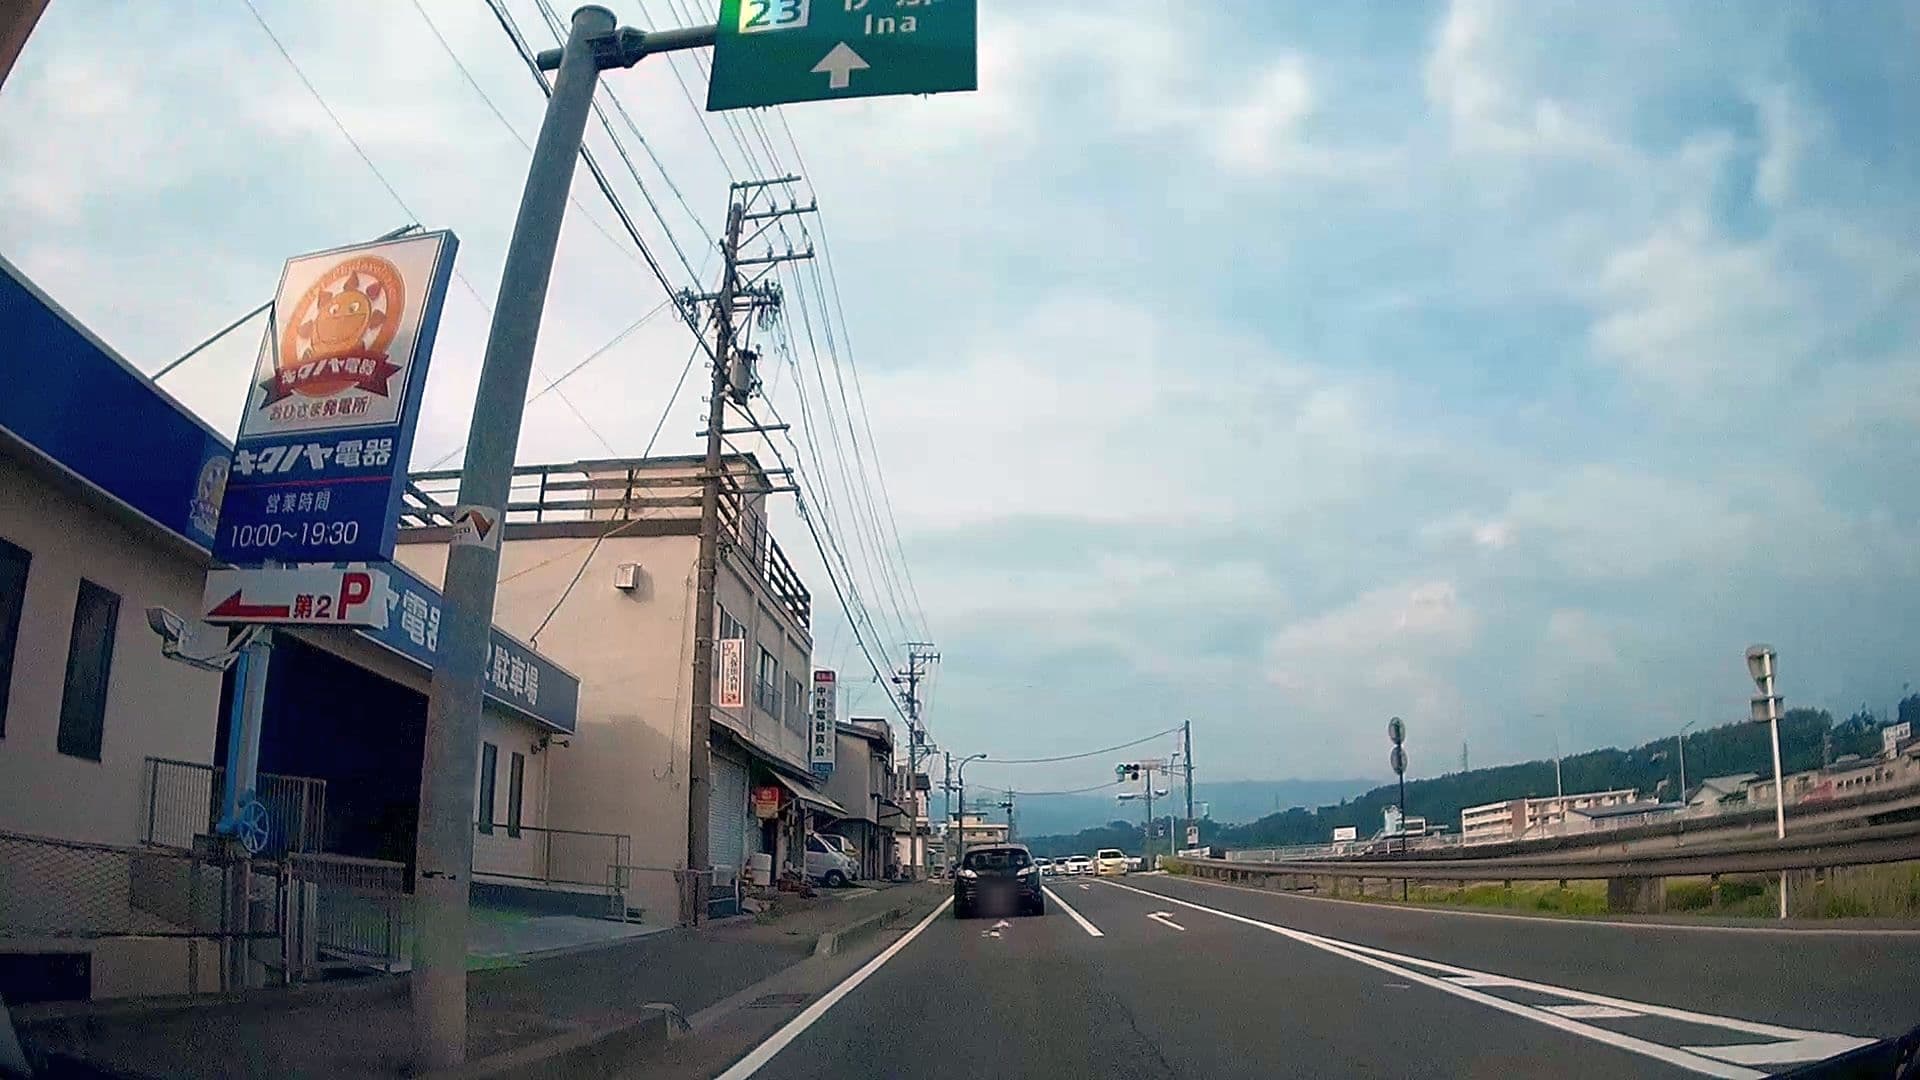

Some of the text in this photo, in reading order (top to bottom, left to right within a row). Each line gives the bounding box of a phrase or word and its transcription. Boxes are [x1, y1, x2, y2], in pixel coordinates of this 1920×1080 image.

[864, 14, 917, 35] Ina
[270, 396, 369, 421] おひさま発電所
[233, 438, 392, 476] キクノヤ電器
[266, 491, 331, 515] 営業時間
